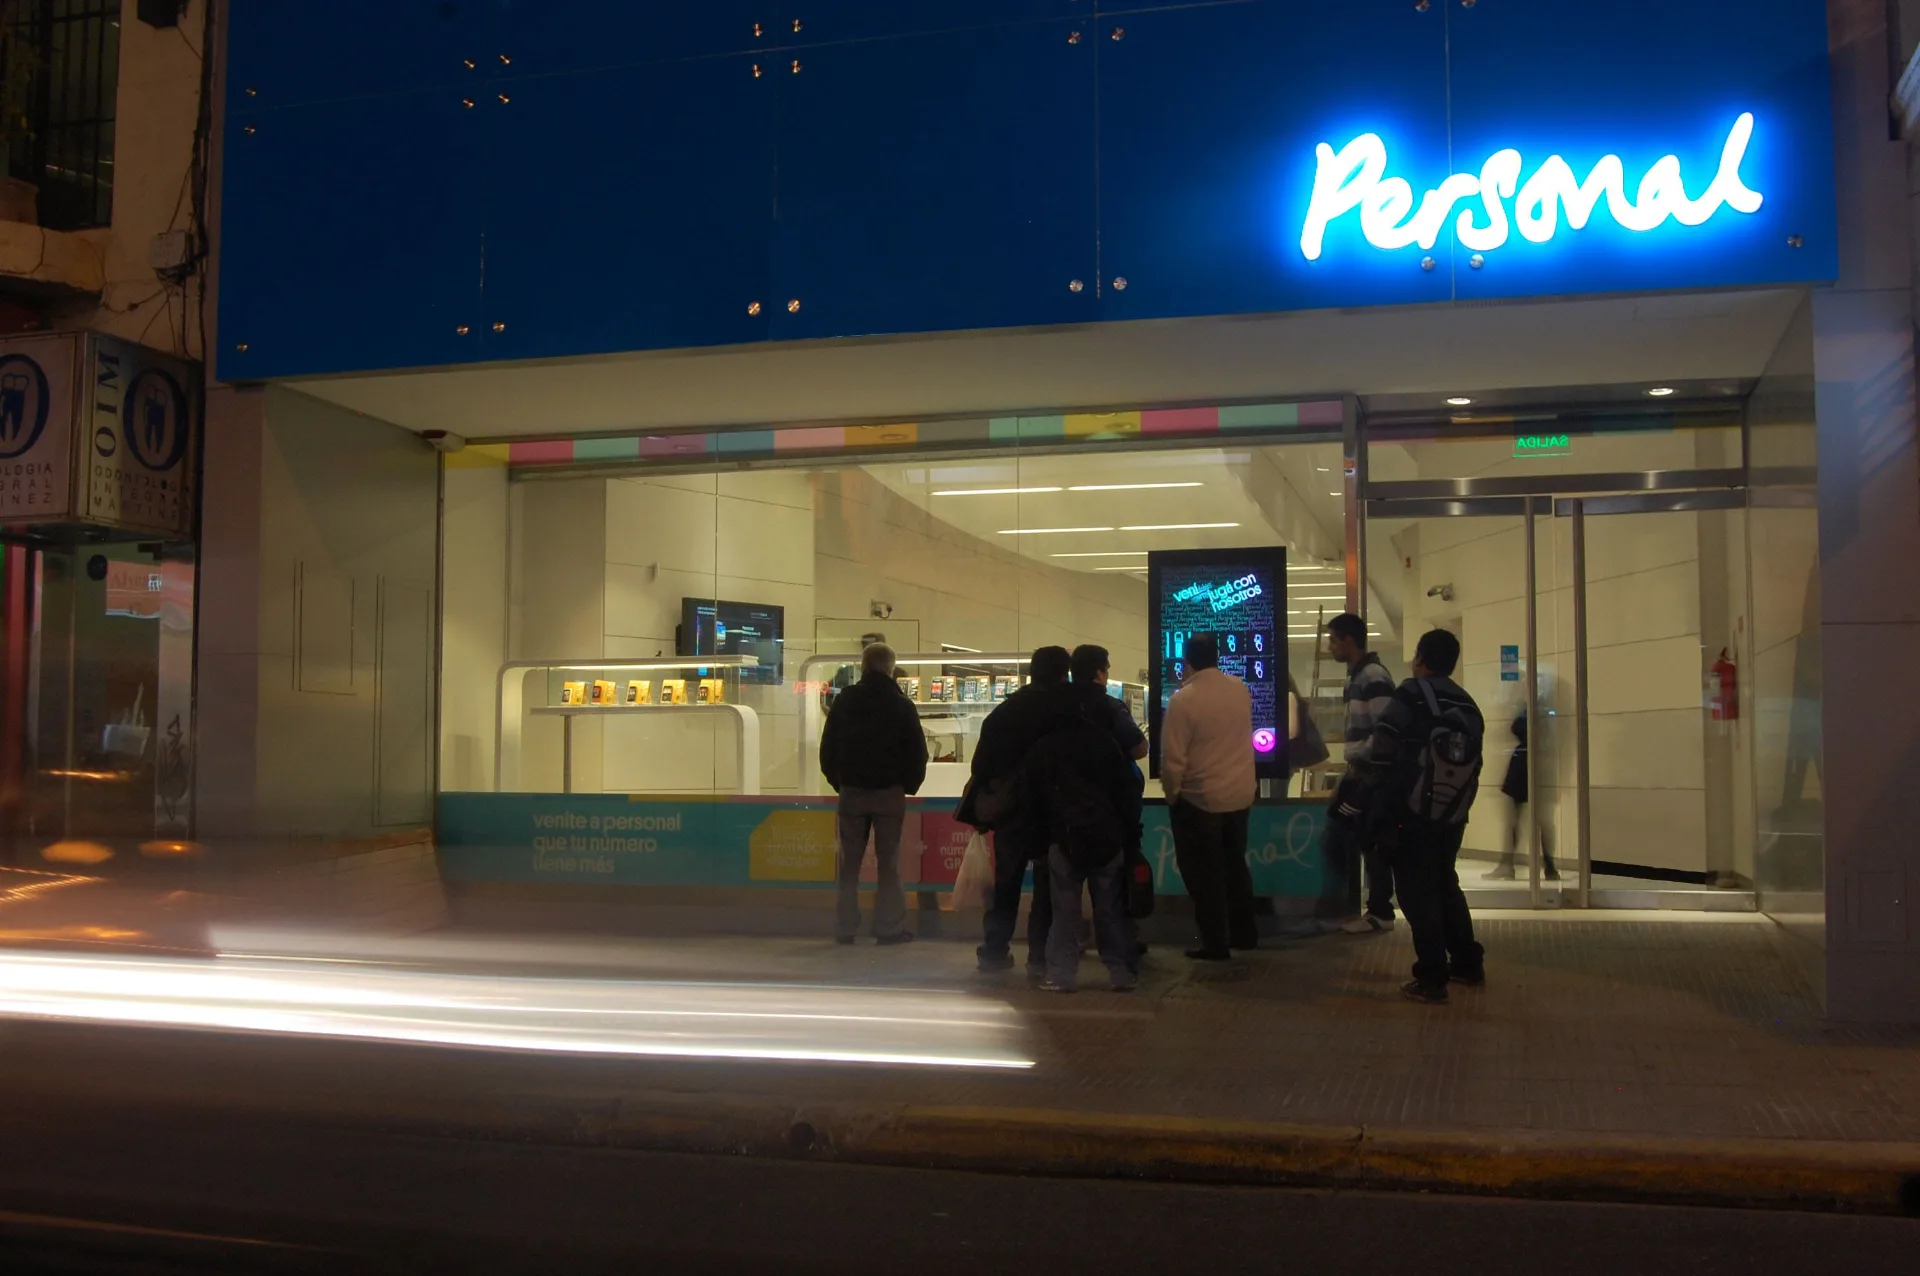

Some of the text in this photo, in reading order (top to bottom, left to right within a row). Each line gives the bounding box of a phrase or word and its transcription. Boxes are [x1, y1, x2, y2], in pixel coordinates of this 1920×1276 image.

[1300, 111, 1764, 261] Personal
[0, 463, 52, 476] LOGIA
[1233, 573, 1257, 590] con
[1210, 584, 1262, 613] nosotros
[590, 815, 600, 830] a
[602, 812, 681, 837] personal
[533, 834, 657, 855] que tu número
[533, 855, 615, 873] tiene más
